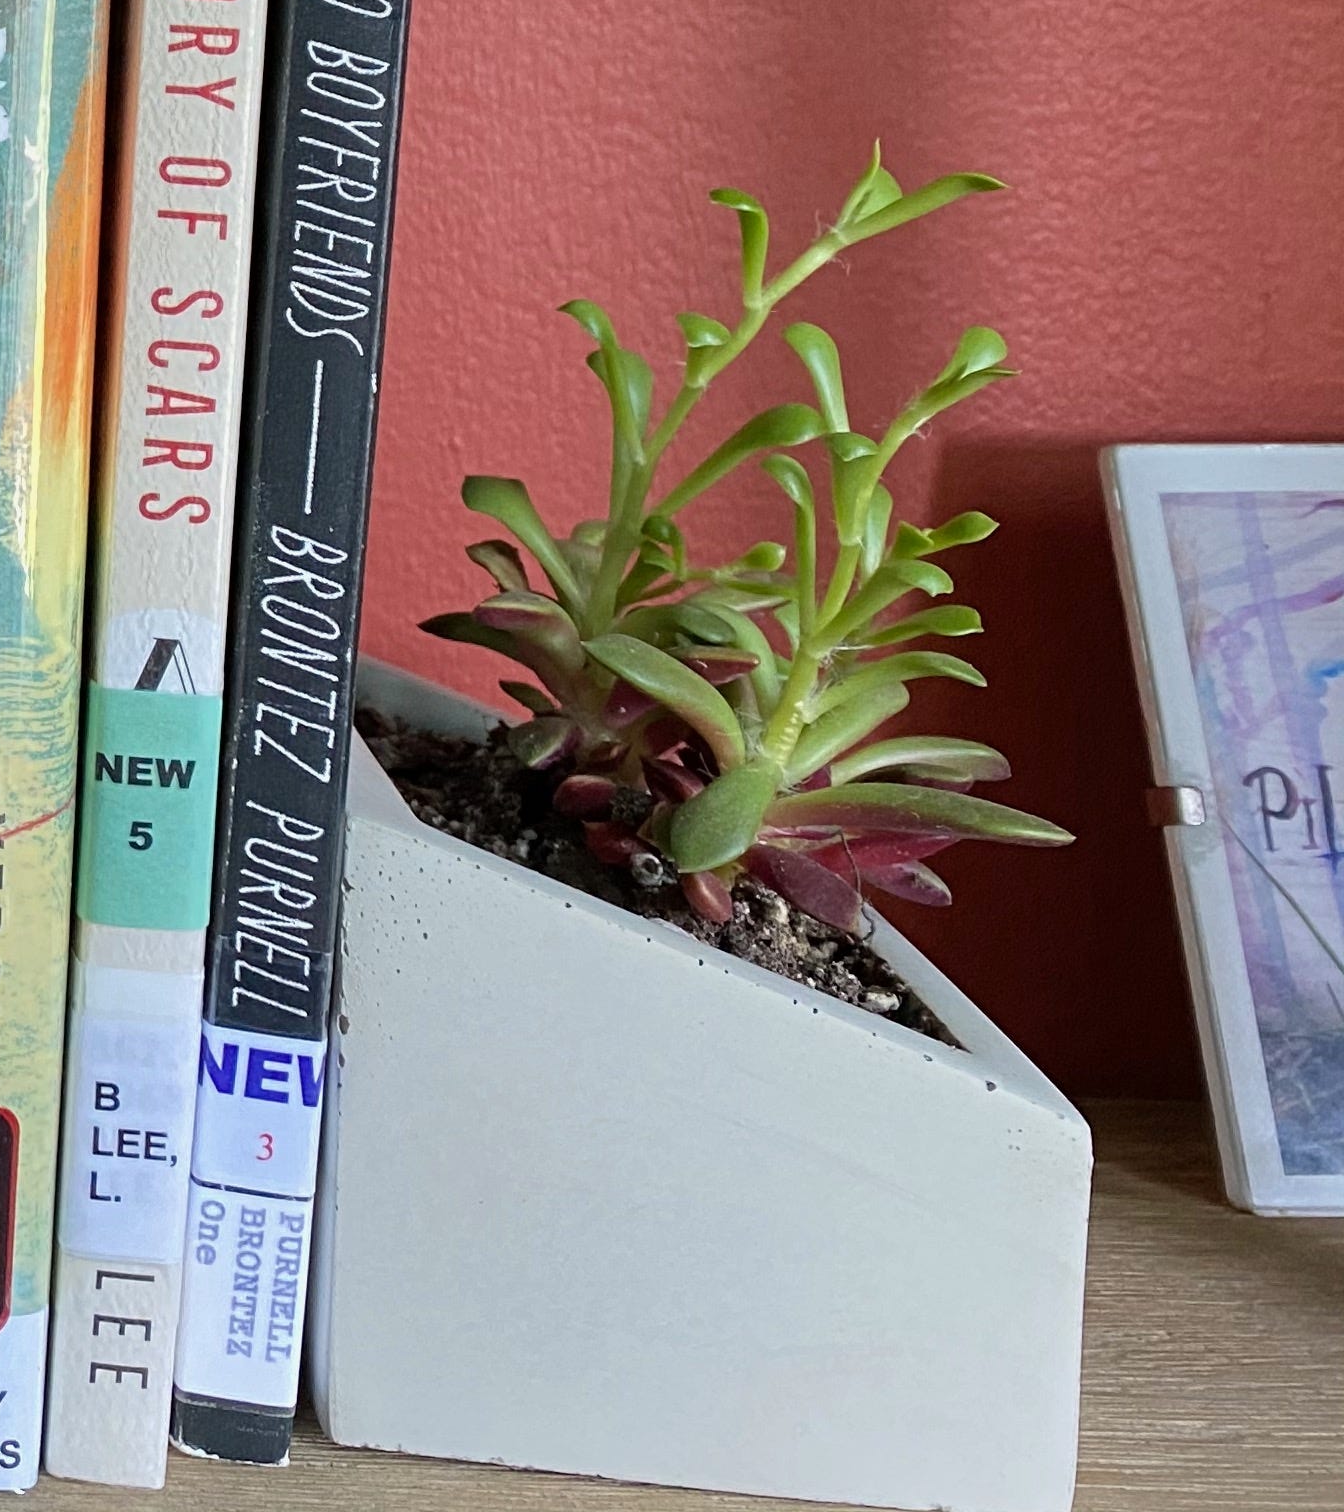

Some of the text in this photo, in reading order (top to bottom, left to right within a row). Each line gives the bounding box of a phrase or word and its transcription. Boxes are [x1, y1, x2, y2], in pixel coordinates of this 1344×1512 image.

[157, 156, 232, 241] OF
[286, 38, 390, 356] BOYFRIENDS
[138, 286, 224, 525] SCARS
[253, 524, 349, 784] BRONTEZ
[95, 753, 195, 789] NEW
[129, 822, 152, 851] 5
[231, 800, 324, 1018] PURNELL
[94, 1081, 120, 1112] B
[90, 1171, 122, 1202] L.
[92, 1126, 178, 1167] LEE,
[255, 1133, 274, 1161] 3
[195, 1200, 226, 1266] One
[226, 1205, 267, 1358] BRONTEZ
[265, 1211, 305, 1364] PURNELL
[89, 1269, 156, 1389] LEE
